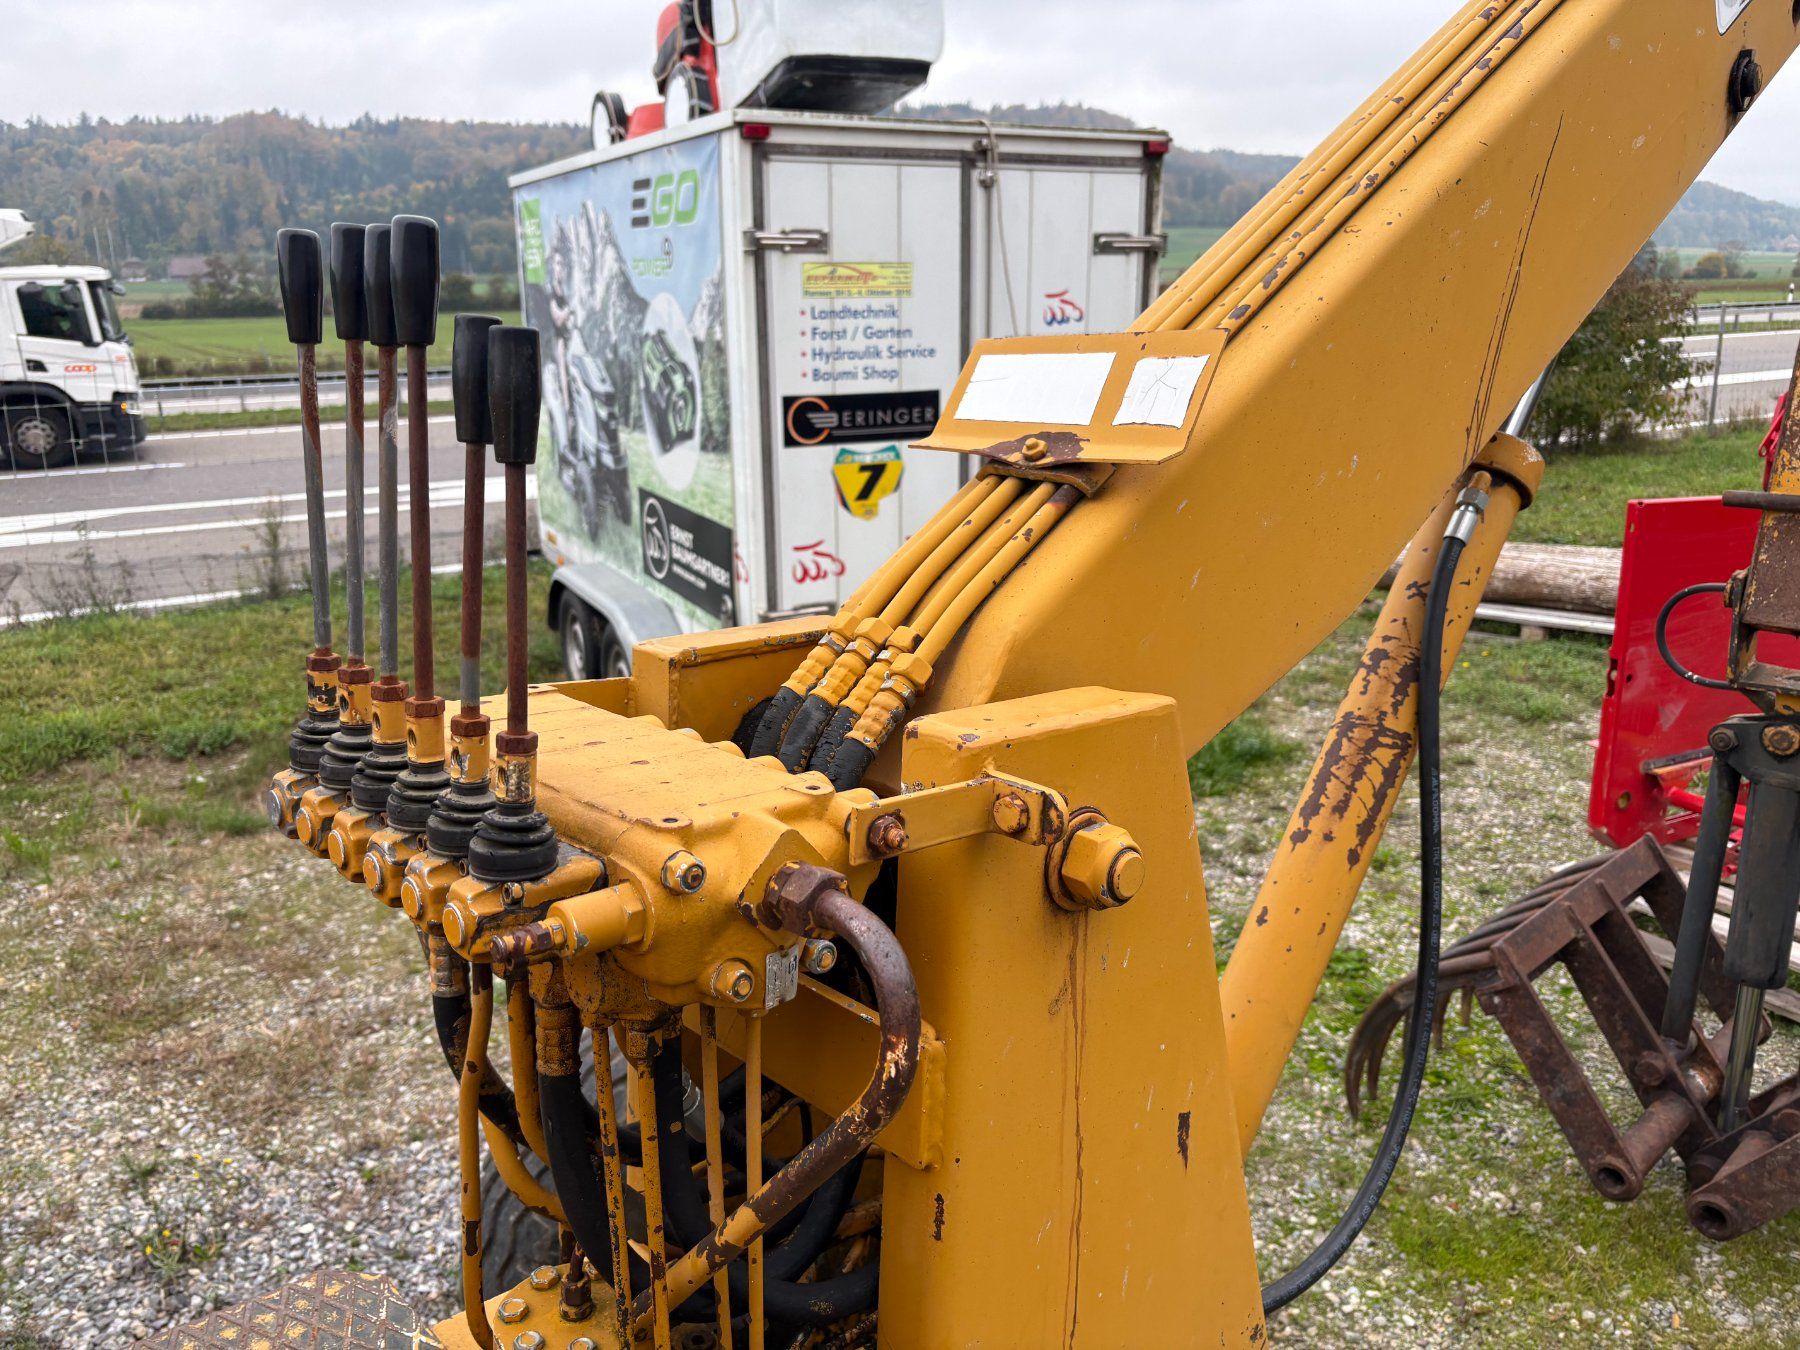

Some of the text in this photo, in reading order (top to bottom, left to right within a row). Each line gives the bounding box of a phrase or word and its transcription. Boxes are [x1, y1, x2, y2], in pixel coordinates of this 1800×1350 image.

[632, 170, 699, 227] EGO
[810, 304, 899, 320] Landtechnik
[811, 325, 913, 341] Forst / Garten
[812, 344, 937, 364] Hydraulik Service
[812, 366, 899, 382] Baumi Shop
[854, 463, 888, 502] 7
[1432, 846, 1440, 866] ITALY
